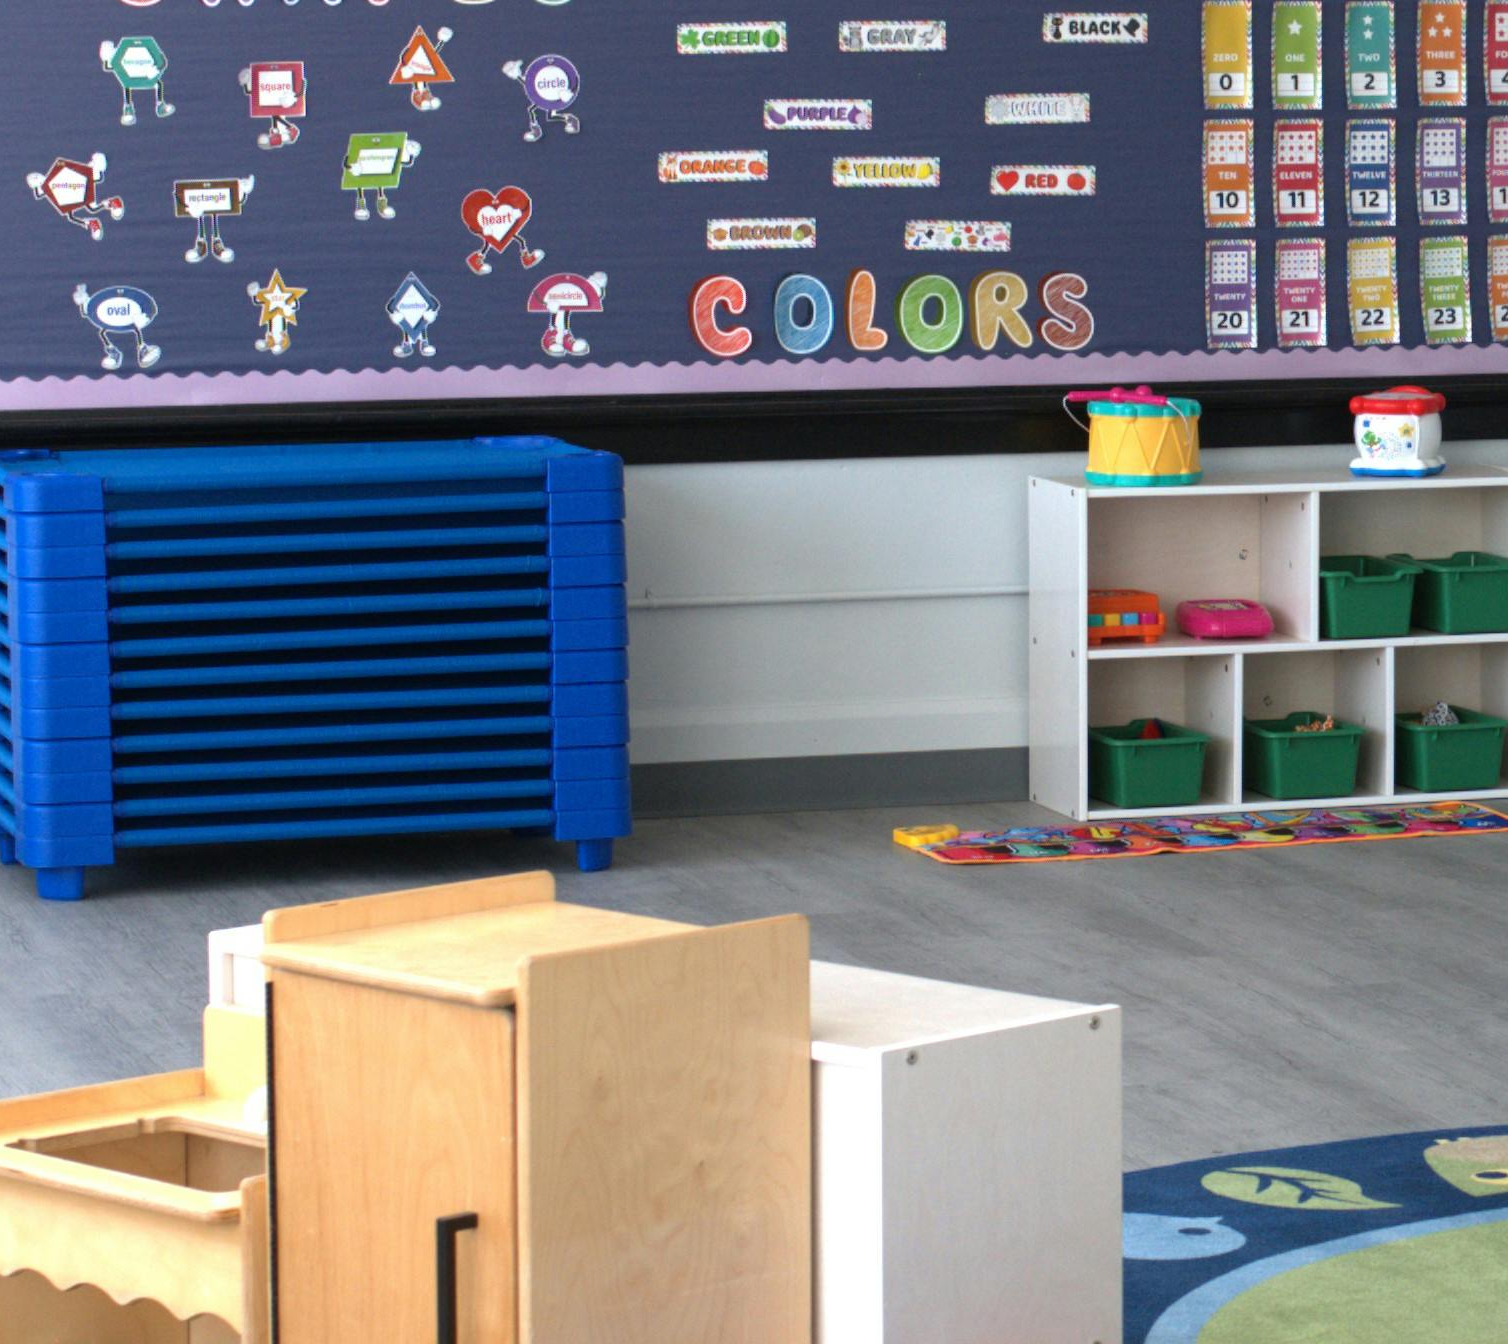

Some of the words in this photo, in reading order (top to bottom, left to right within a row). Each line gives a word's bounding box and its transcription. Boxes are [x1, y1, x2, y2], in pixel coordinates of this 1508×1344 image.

[1068, 19, 1122, 36] BLACK
[701, 29, 761, 45] GREEN
[867, 28, 917, 45] GRAY
[1213, 54, 1238, 62] ZERO
[1285, 54, 1305, 62] ONE
[1358, 54, 1380, 62] TWO
[1426, 51, 1455, 60] THREE
[537, 78, 566, 89] circle
[1220, 74, 1232, 90] 0
[1291, 75, 1299, 90] 1
[1365, 74, 1375, 90] 2
[1435, 71, 1446, 87] 3
[260, 82, 291, 92] square
[787, 106, 848, 122] PURPLE
[1010, 101, 1066, 117] WHITE
[679, 158, 747, 174] ORANGE
[852, 162, 917, 179] YELLOW
[1025, 173, 1058, 188] RED
[1218, 172, 1237, 180] TEN
[1280, 171, 1312, 180] ELEVEN
[1353, 171, 1386, 180] TWELVE
[1423, 170, 1458, 178] THIRTEEN
[52, 182, 86, 190] pentagon
[189, 192, 227, 202] rectangle
[1216, 192, 1239, 208] 10
[1288, 192, 1305, 208] 11
[1359, 192, 1379, 208] 12
[1430, 190, 1451, 206] 13
[481, 212, 511, 225] heart
[729, 225, 792, 240] BROWN
[1284, 287, 1315, 295] TWENTY
[1356, 285, 1387, 294] TWENTY
[1429, 285, 1459, 293] TWENTY
[1215, 293, 1246, 301] TWENTY
[1292, 295, 1308, 303] ONE
[107, 303, 131, 315] oval
[690, 270, 1095, 356] COLORS
[1434, 309, 1456, 324] 23
[1217, 313, 1242, 329] 20
[1290, 311, 1310, 327] 21
[1361, 309, 1385, 326] 22
